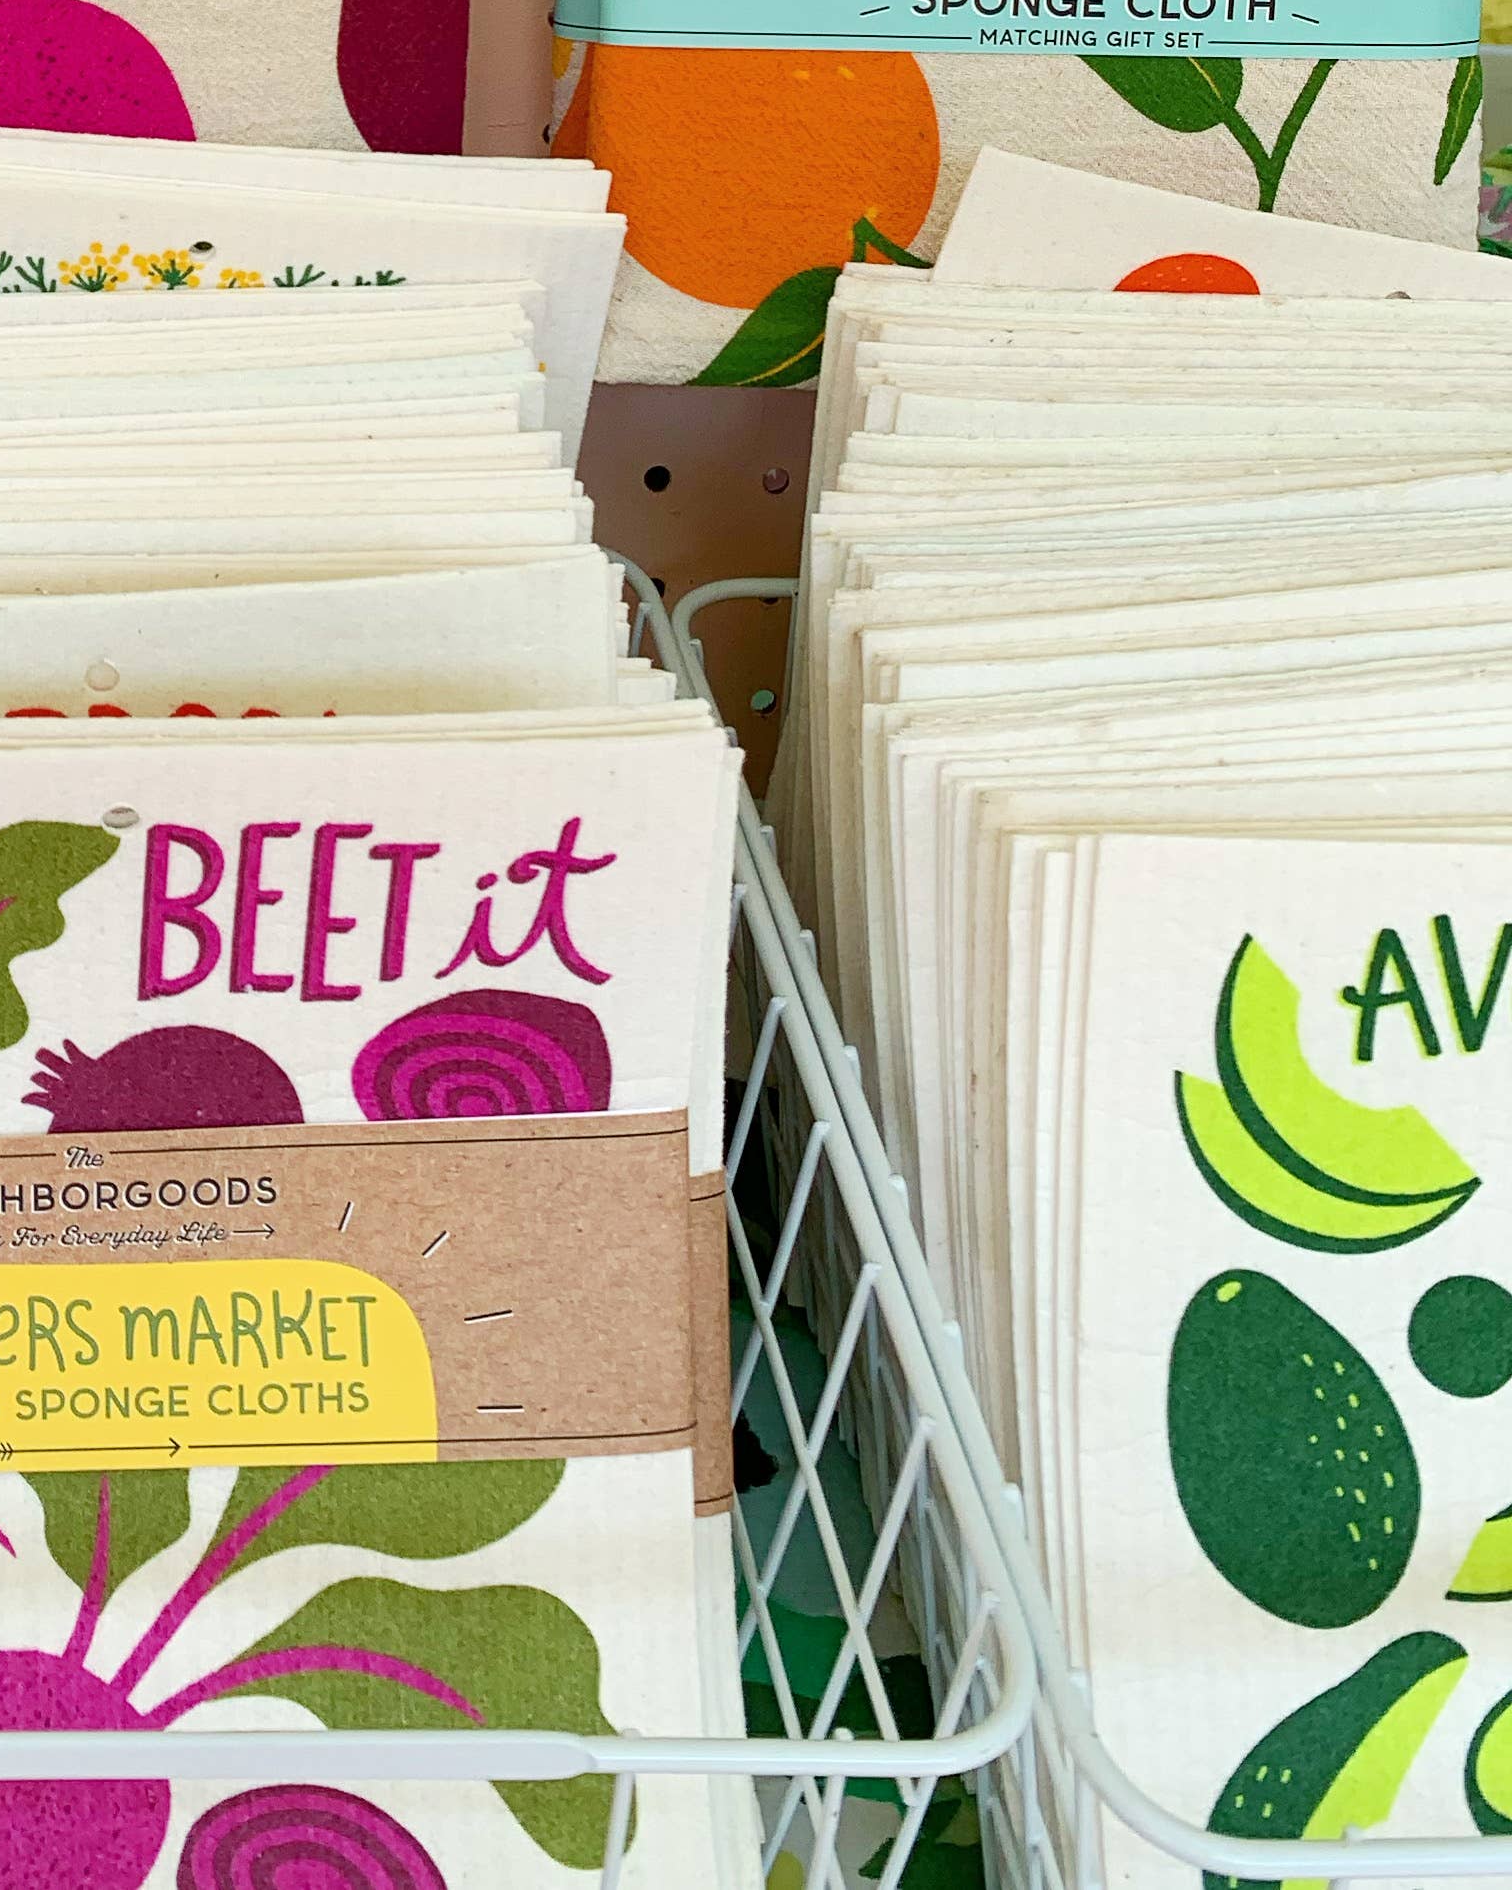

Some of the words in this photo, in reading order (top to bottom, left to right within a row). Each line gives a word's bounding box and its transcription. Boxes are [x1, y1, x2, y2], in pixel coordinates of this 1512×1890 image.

[979, 28, 1097, 46] MATCHING
[1106, 31, 1156, 47] GIFT
[1163, 32, 1204, 48] SET
[138, 822, 440, 1002] BEET
[434, 817, 616, 985] it
[66, 1146, 105, 1167] The
[11, 1226, 56, 1246] For
[60, 1223, 172, 1249] Everyday
[176, 1221, 227, 1246] Life
[15, 1385, 190, 1420] SPONGE
[207, 1381, 369, 1415] CLOTHS
